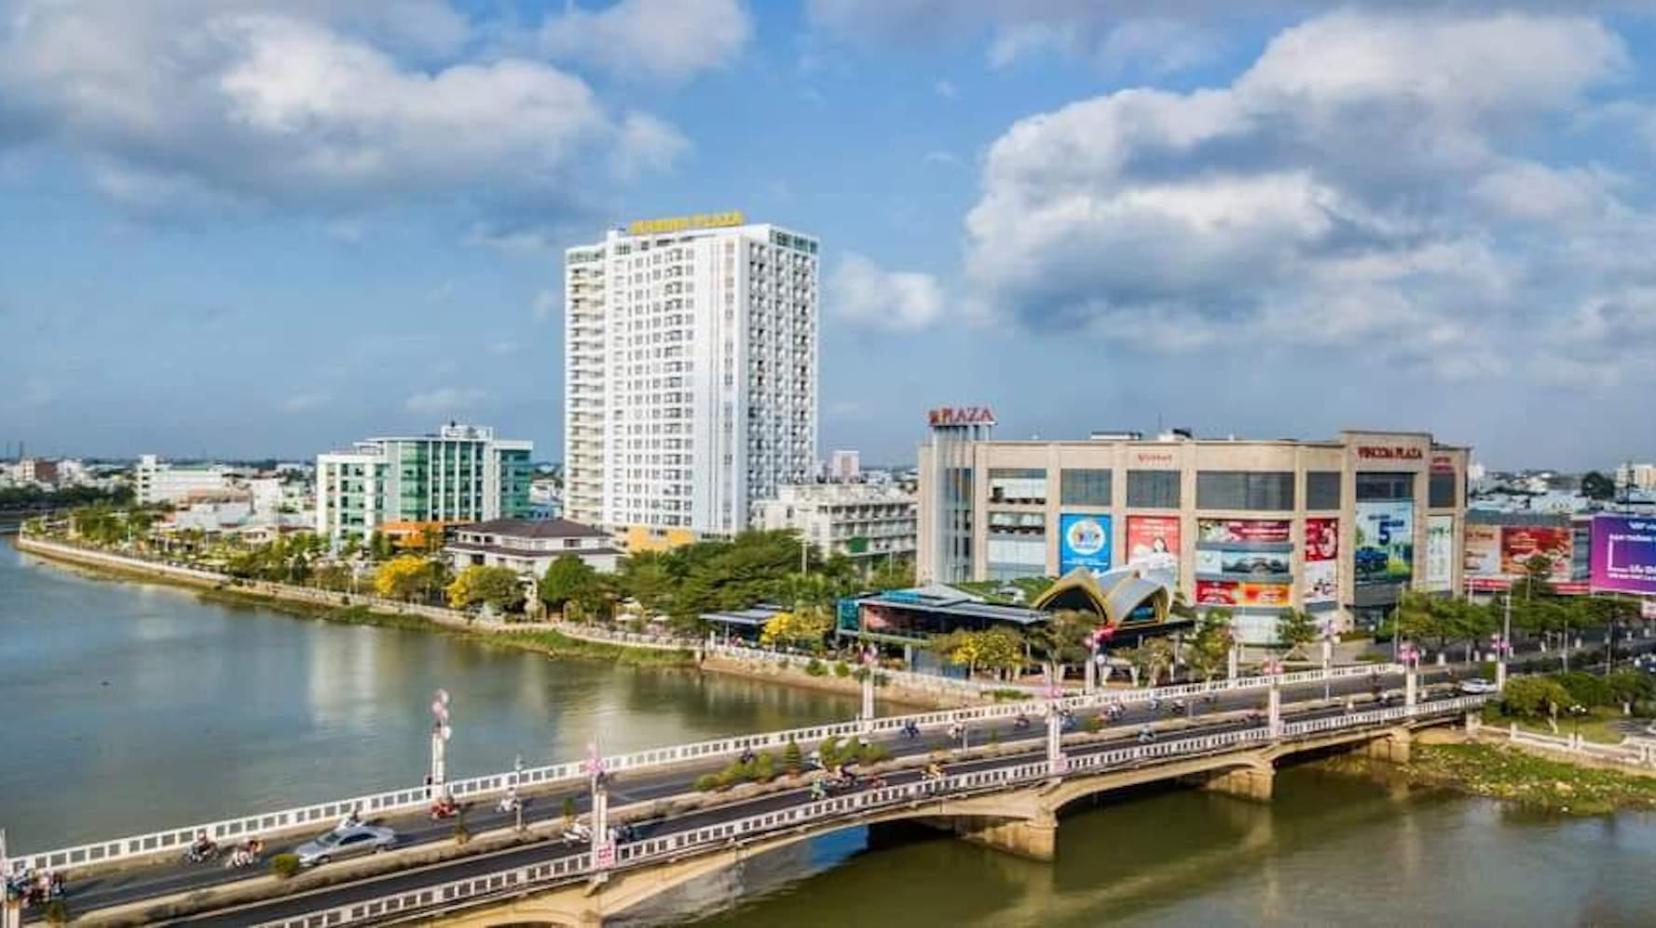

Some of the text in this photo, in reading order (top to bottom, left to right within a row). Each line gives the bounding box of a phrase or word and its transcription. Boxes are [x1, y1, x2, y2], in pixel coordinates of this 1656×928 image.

[940, 406, 994, 425] PLAZA
[1396, 446, 1423, 460] PLAZA
[1379, 521, 1391, 546] 5
